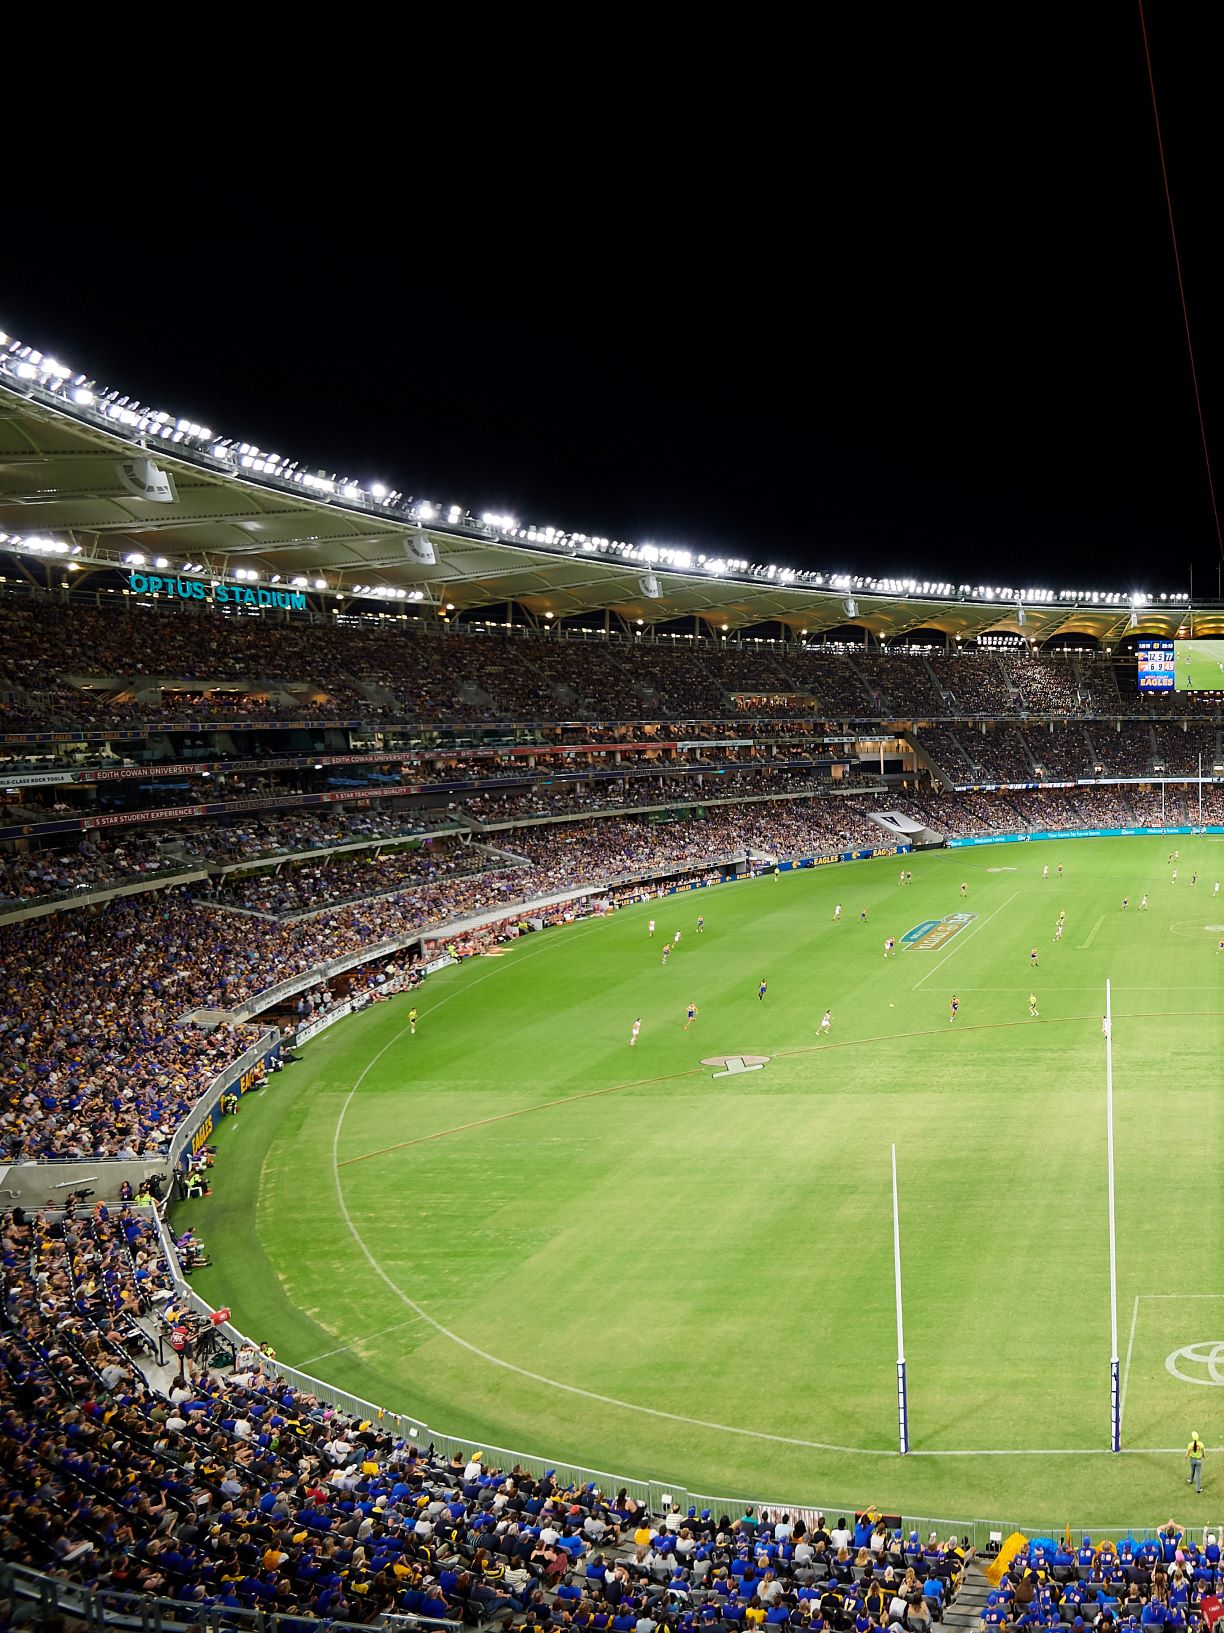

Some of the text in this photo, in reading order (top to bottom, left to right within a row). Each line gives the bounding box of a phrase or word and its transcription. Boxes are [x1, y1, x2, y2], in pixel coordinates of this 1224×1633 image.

[130, 574, 307, 609] OPTUS STADIUM
[1149, 653, 1156, 661] 12
[351, 755, 373, 763] COWAN
[374, 753, 410, 762] UNIVERSITY
[232, 762, 263, 770] GOLDEN
[97, 771, 120, 779] EDITH
[121, 769, 149, 778] COWAN
[150, 765, 194, 775] UNIVERSITY
[383, 788, 407, 796] QUALITY
[101, 817, 118, 825] STAR
[120, 813, 150, 823] STUDENT
[151, 808, 193, 820] EXPERIENCE
[814, 855, 839, 866] EAGLES
[676, 884, 691, 893] EAGLES
[192, 1114, 213, 1156] EAGLES
[844, 1597, 856, 1611] 17
